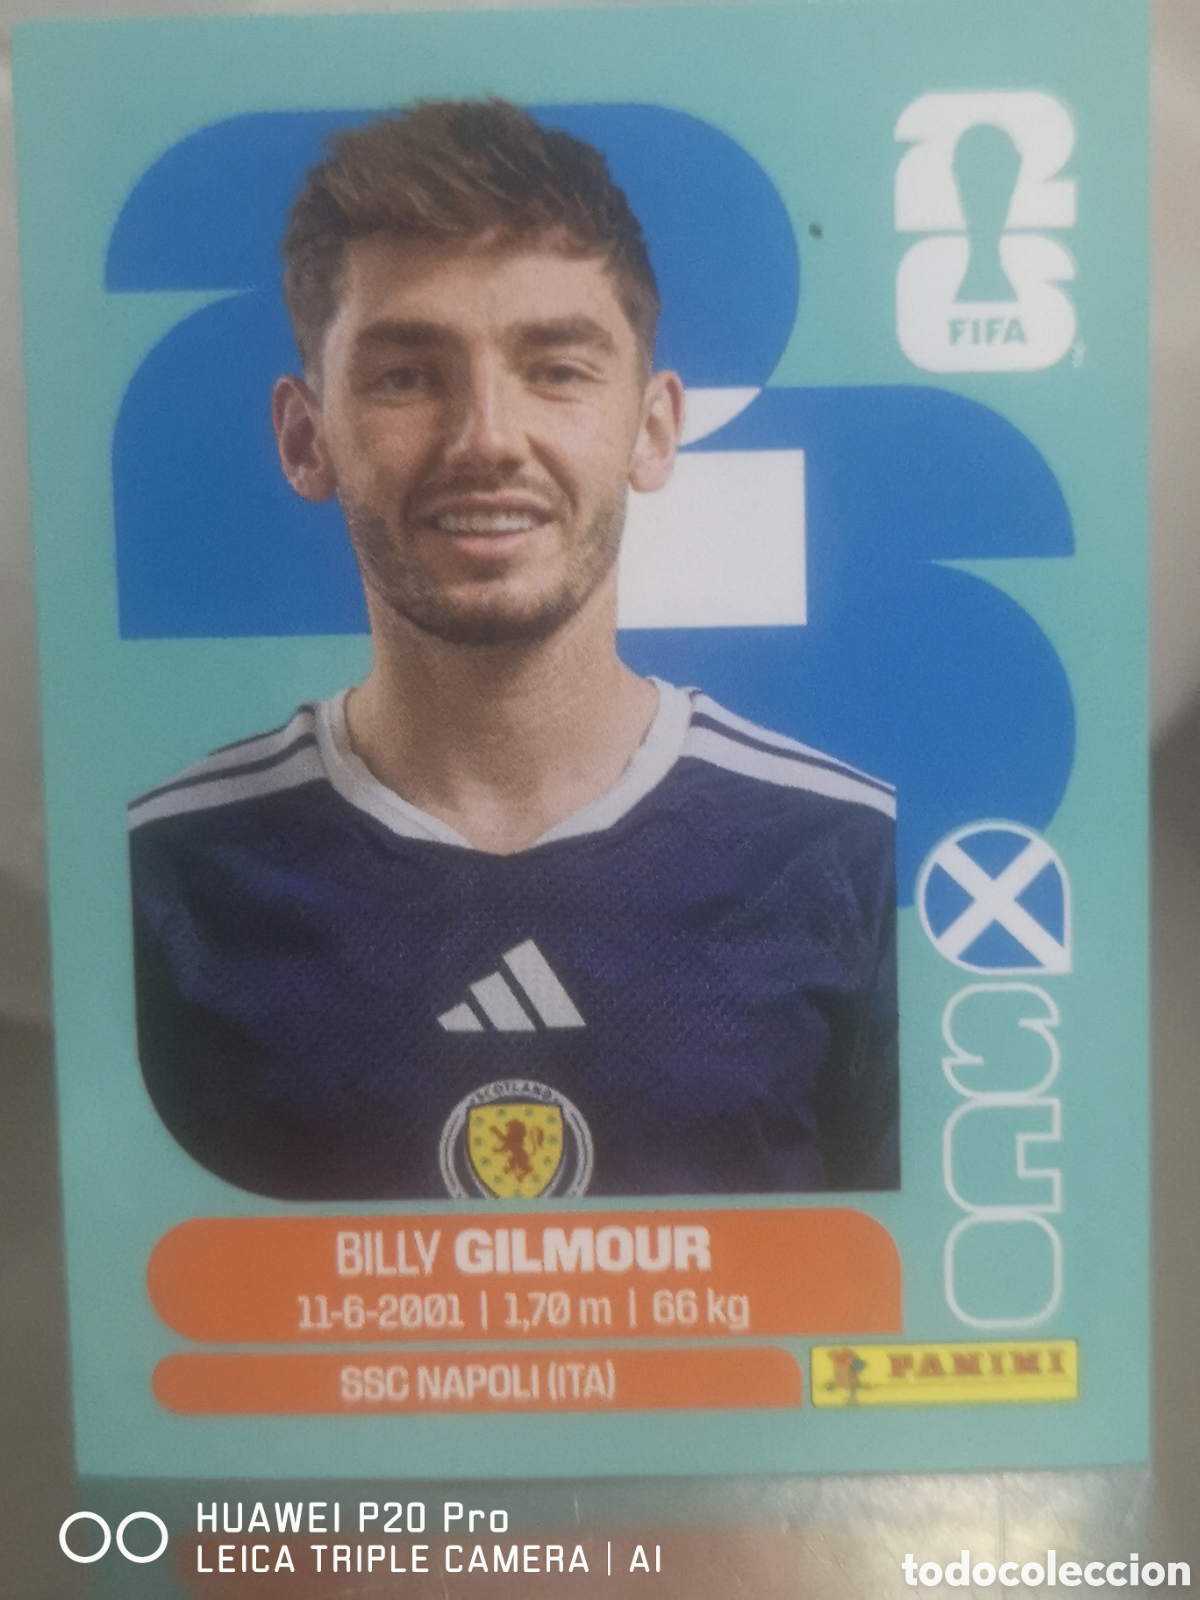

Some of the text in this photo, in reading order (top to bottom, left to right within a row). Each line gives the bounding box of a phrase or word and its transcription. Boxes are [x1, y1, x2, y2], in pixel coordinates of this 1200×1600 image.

[949, 317, 1027, 346] FIFA
[941, 982, 1063, 1329] SCO
[336, 1226, 712, 1276] BILLY GILMOUR
[298, 1293, 465, 1330] 11-6-2001
[504, 1291, 571, 1332] 1,70
[579, 1297, 612, 1325] m
[652, 1289, 699, 1325] 66
[706, 1287, 750, 1331] kg
[340, 1359, 616, 1402] SSC NAPOLI (ITA)
[887, 1347, 1066, 1379] PANINI
